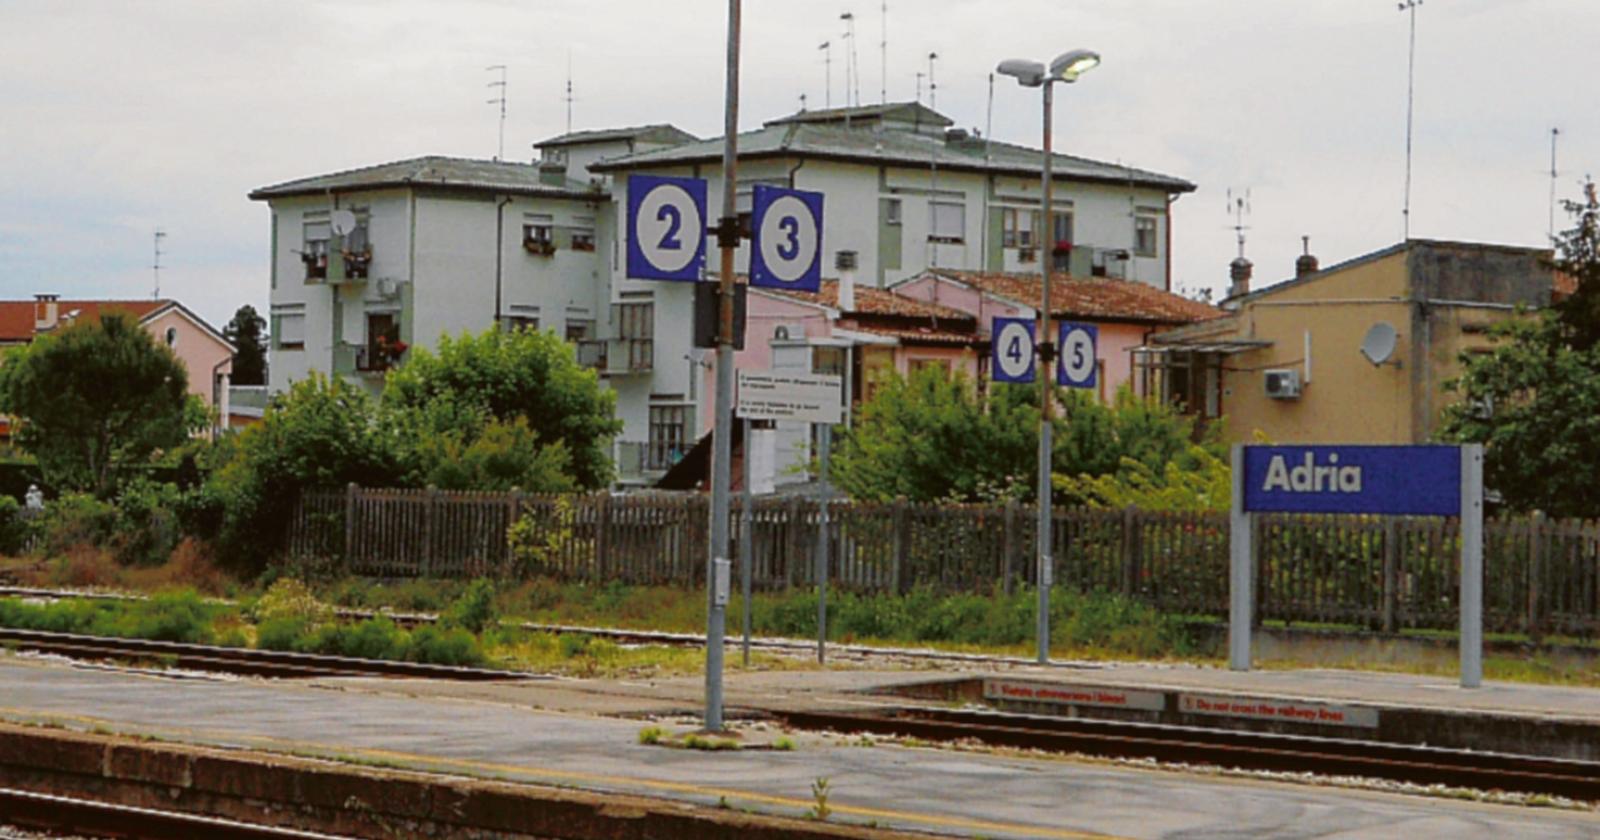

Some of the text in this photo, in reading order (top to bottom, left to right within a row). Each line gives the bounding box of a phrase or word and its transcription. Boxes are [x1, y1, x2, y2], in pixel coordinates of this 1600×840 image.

[657, 204, 682, 250] 2
[777, 215, 799, 261] 3
[1006, 335, 1022, 365] 4
[1072, 341, 1085, 371] 5
[1263, 451, 1362, 492] Adria
[1196, 698, 1212, 711] Do
[1214, 702, 1230, 712] not
[1231, 703, 1256, 715] cross
[1258, 703, 1276, 716] the
[1278, 705, 1317, 721] railway
